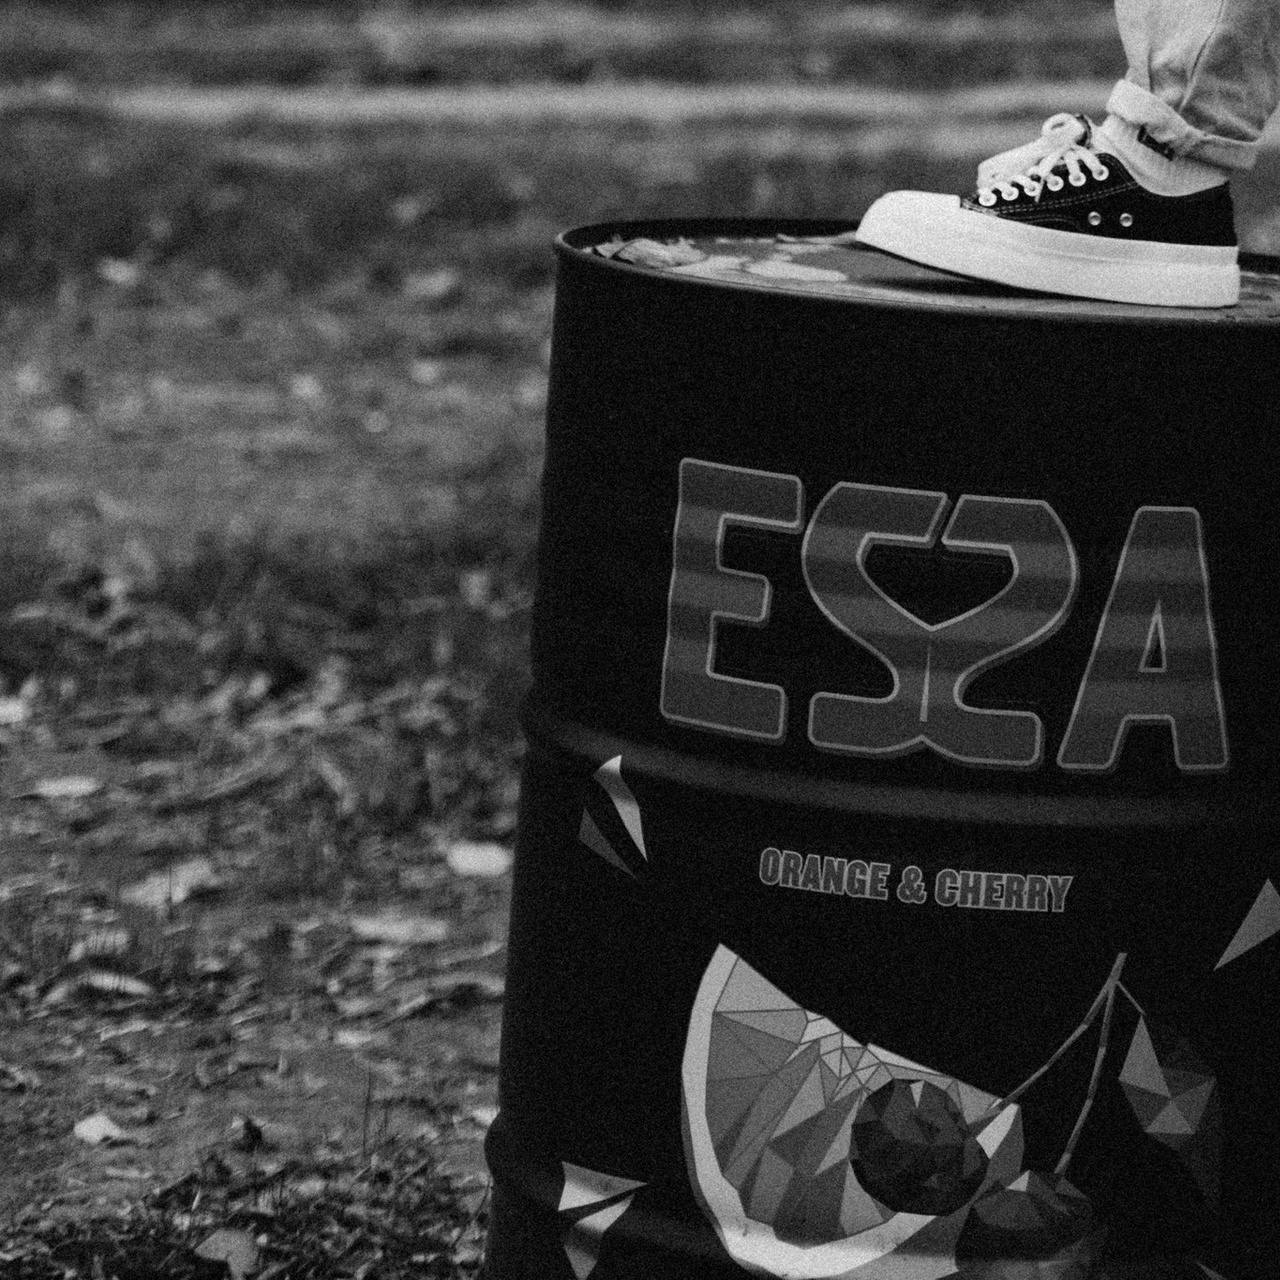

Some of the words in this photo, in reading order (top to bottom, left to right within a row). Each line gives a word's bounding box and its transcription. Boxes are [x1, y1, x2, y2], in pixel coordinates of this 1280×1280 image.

[758, 847, 892, 901] ORANGE
[896, 865, 927, 904] &
[934, 869, 1074, 913] CHERRY
